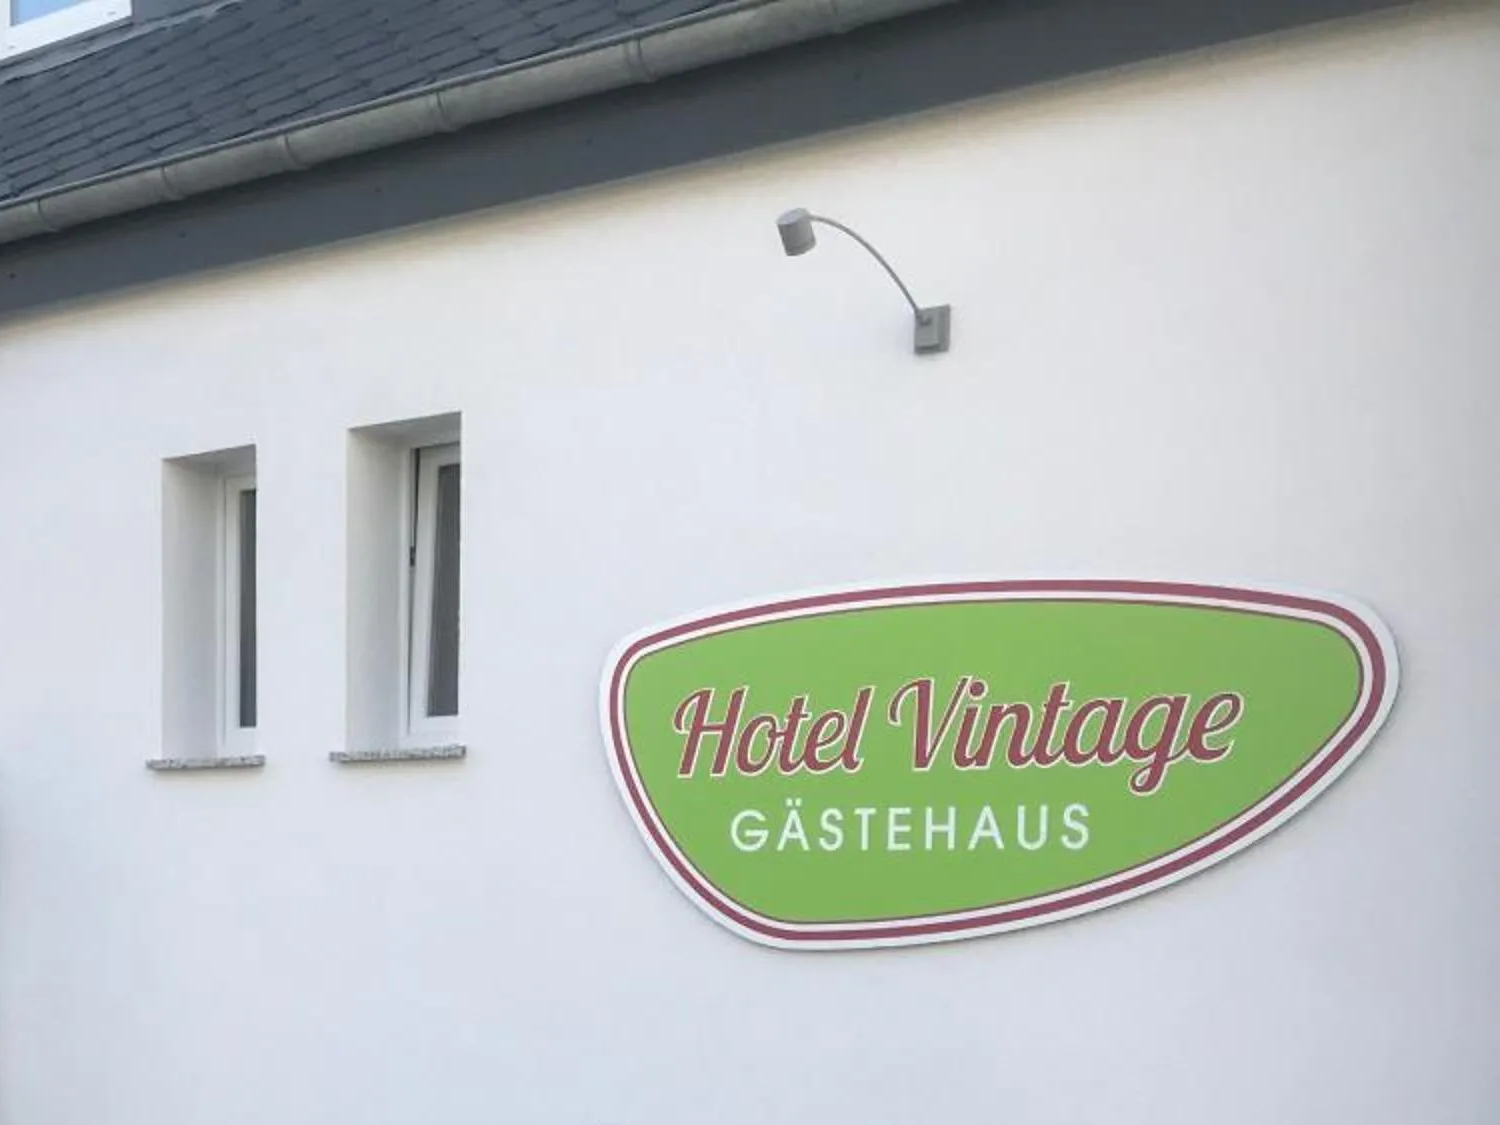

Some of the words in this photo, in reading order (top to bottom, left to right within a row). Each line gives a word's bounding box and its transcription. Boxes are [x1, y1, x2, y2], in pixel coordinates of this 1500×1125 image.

[672, 685, 876, 778] Hotel
[887, 675, 1245, 796] Vintage
[730, 798, 1090, 851] GÄSTEHAUS
